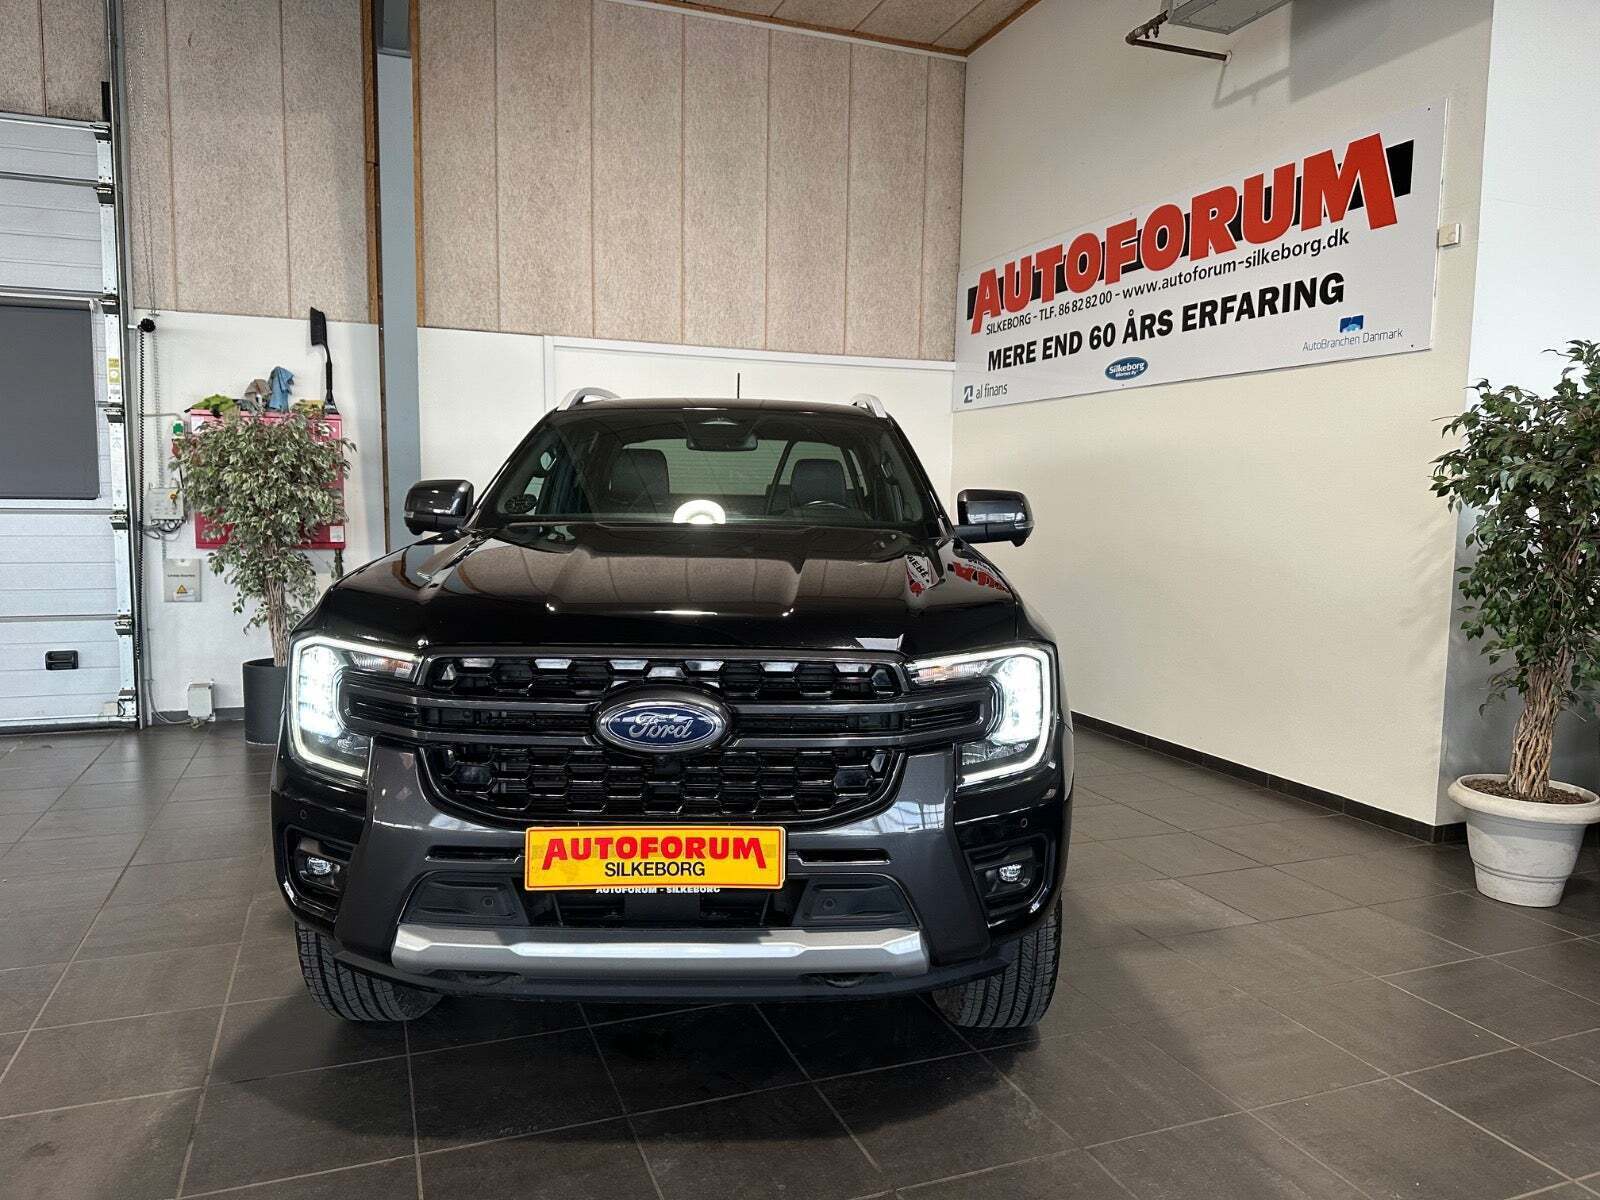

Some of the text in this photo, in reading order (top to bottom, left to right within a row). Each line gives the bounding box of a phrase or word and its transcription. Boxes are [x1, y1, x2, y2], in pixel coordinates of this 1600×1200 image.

[970, 132, 1398, 335] AUTOFORUM
[986, 313, 1031, 336] SILKEBORG
[1039, 306, 1057, 321] TLF.
[1123, 227, 1350, 299] www.autoforum-silkeborg.dk
[987, 272, 1345, 372] MERE END 60 ÅRS ERFARING
[1302, 328, 1403, 352] AutoBranchen Danmark
[1109, 362, 1145, 374] Silkeborg
[984, 383, 1008, 398] finans
[628, 711, 694, 739] Ford
[541, 836, 767, 871] AUTOFORUM
[604, 861, 705, 878] SILKEBORG
